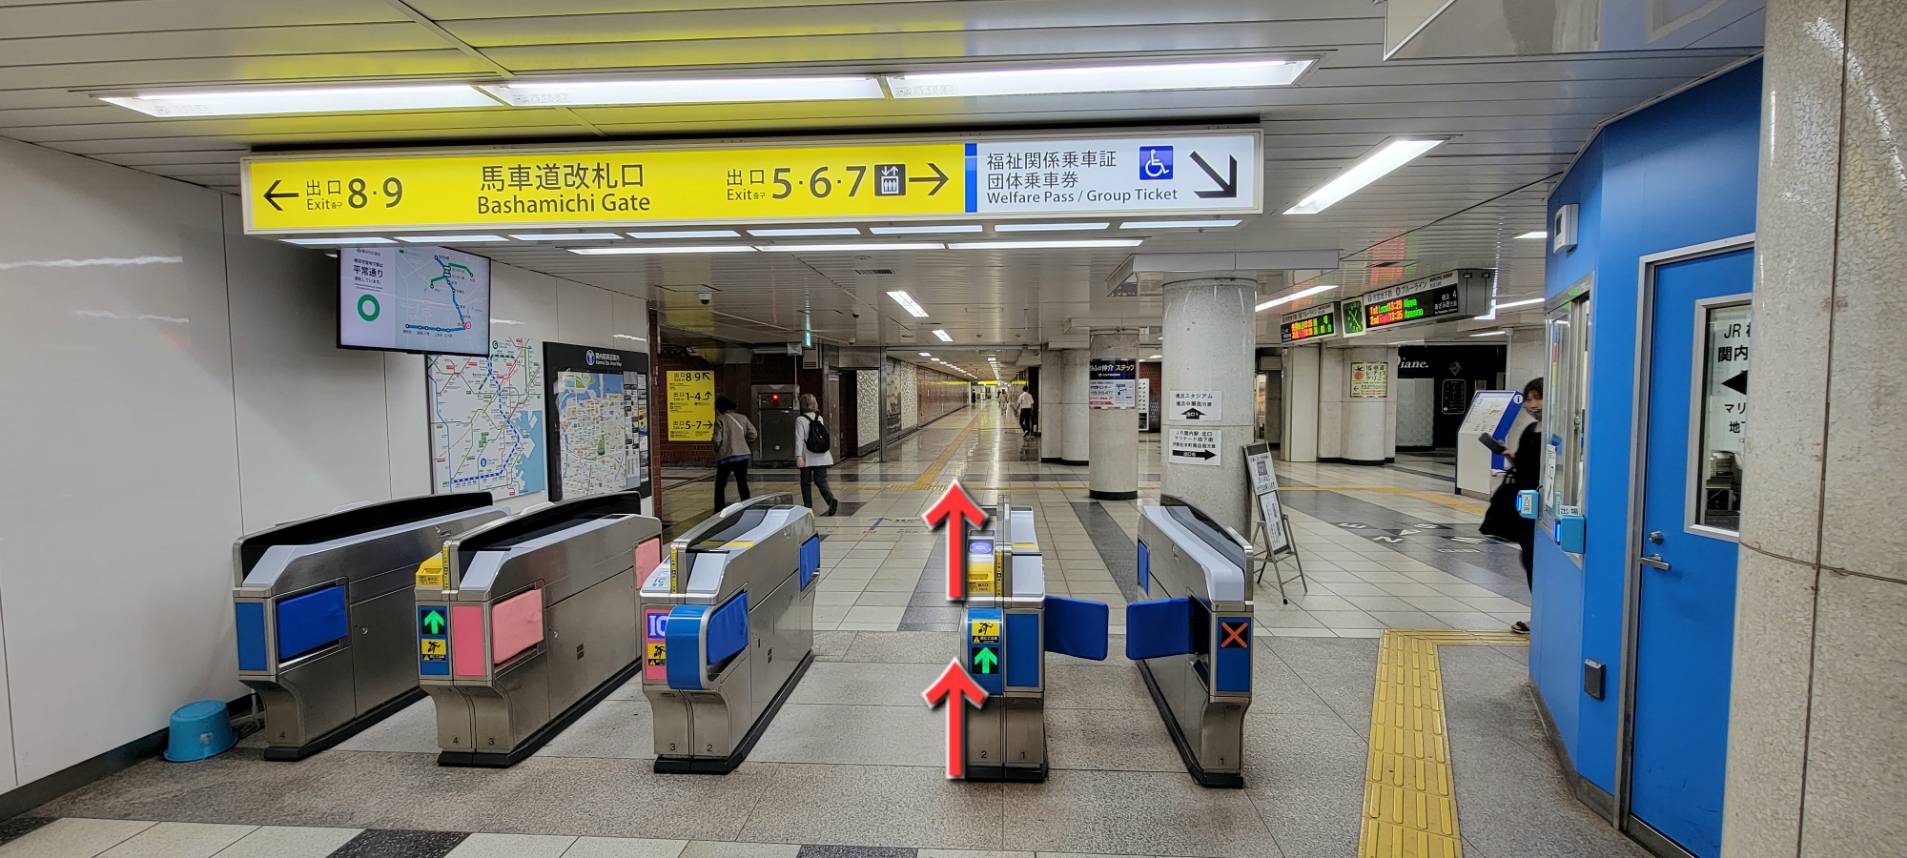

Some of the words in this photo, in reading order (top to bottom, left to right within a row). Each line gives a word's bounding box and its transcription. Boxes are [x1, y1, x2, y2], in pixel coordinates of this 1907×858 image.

[987, 150, 1117, 170] 福祉関係乗車証
[481, 163, 645, 192] 馬車道改札口
[726, 169, 764, 185] 出口
[987, 171, 1079, 190] 団体乗車券
[306, 179, 341, 195] 出口
[727, 188, 752, 200] Exit
[987, 191, 1040, 204] Welfare
[1044, 191, 1075, 203] Pass
[1087, 190, 1131, 204] Group
[1135, 188, 1178, 201] Ticket
[307, 198, 330, 210] Exit
[478, 194, 596, 214] Bashamichi
[602, 193, 650, 213] Gate
[1452, 289, 1457, 298] 4
[1724, 323, 1741, 338] JR
[1718, 345, 1748, 362] 関内
[1398, 355, 1429, 369] iane.
[1729, 421, 1746, 433] 地
[488, 737, 494, 746] 3
[670, 743, 676, 751] 3
[706, 744, 713, 752] 2
[980, 751, 987, 759] 2
